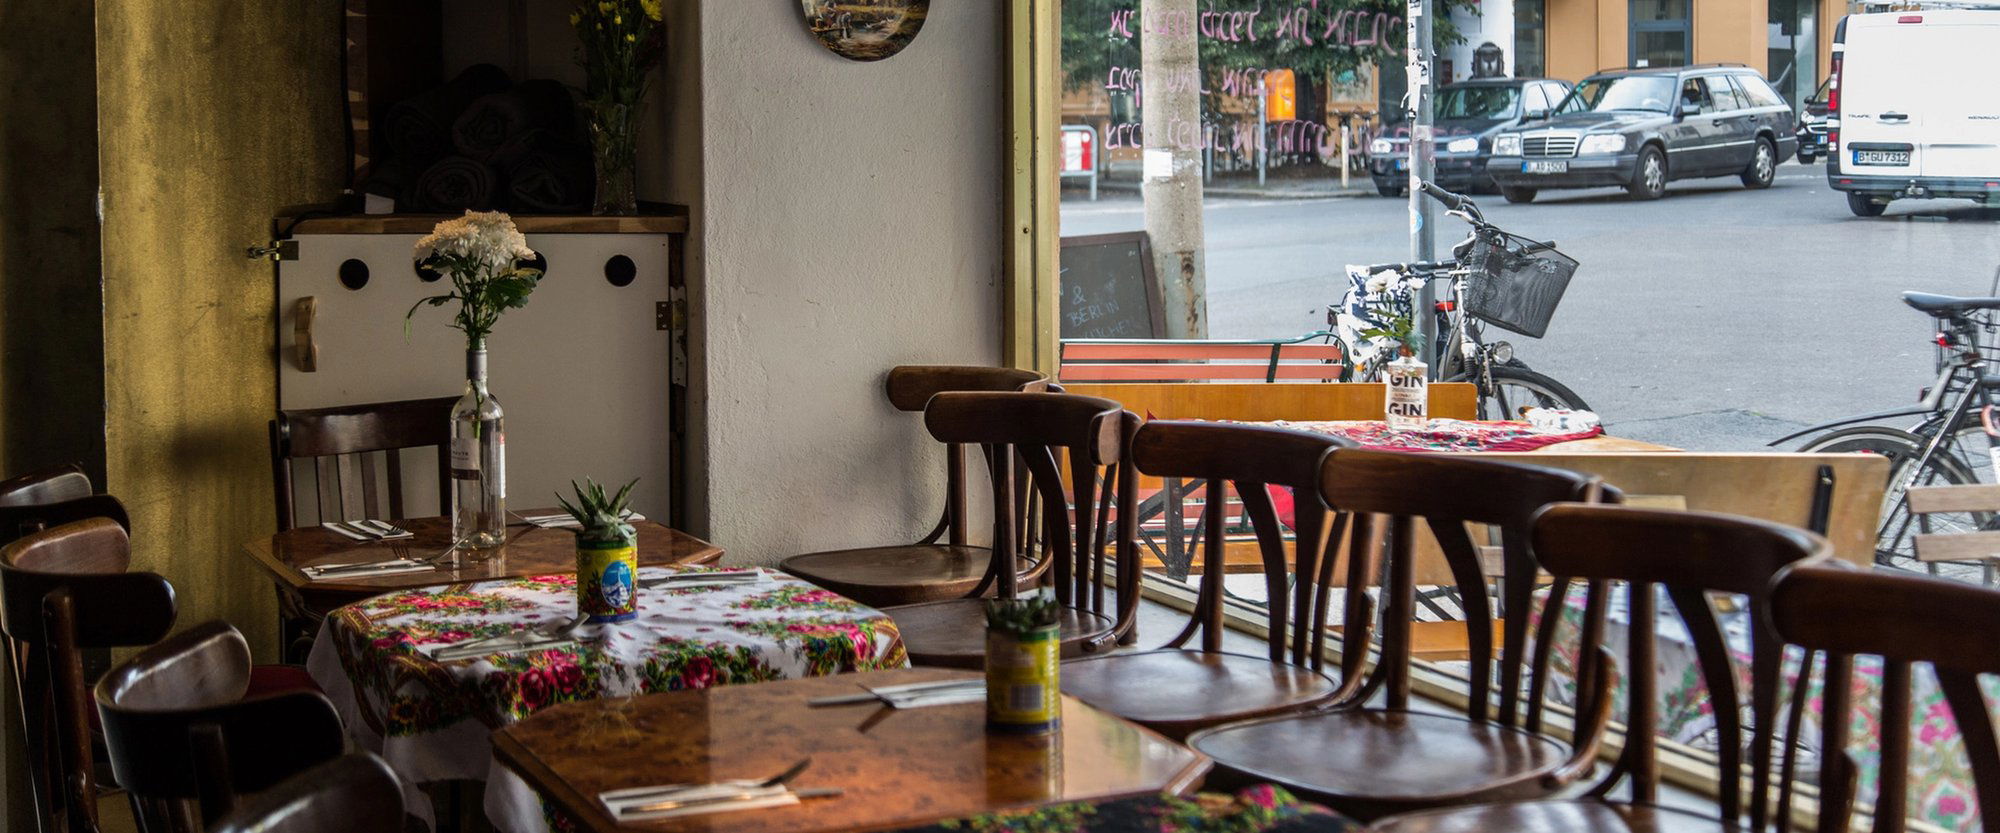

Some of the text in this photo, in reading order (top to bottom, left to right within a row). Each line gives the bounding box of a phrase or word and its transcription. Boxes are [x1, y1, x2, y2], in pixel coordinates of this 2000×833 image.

[1885, 152, 1908, 162] 7312
[1073, 285, 1087, 305] &
[1067, 299, 1120, 328] BERLIN
[1390, 374, 1423, 388] GIN
[1388, 402, 1422, 416] GIN
